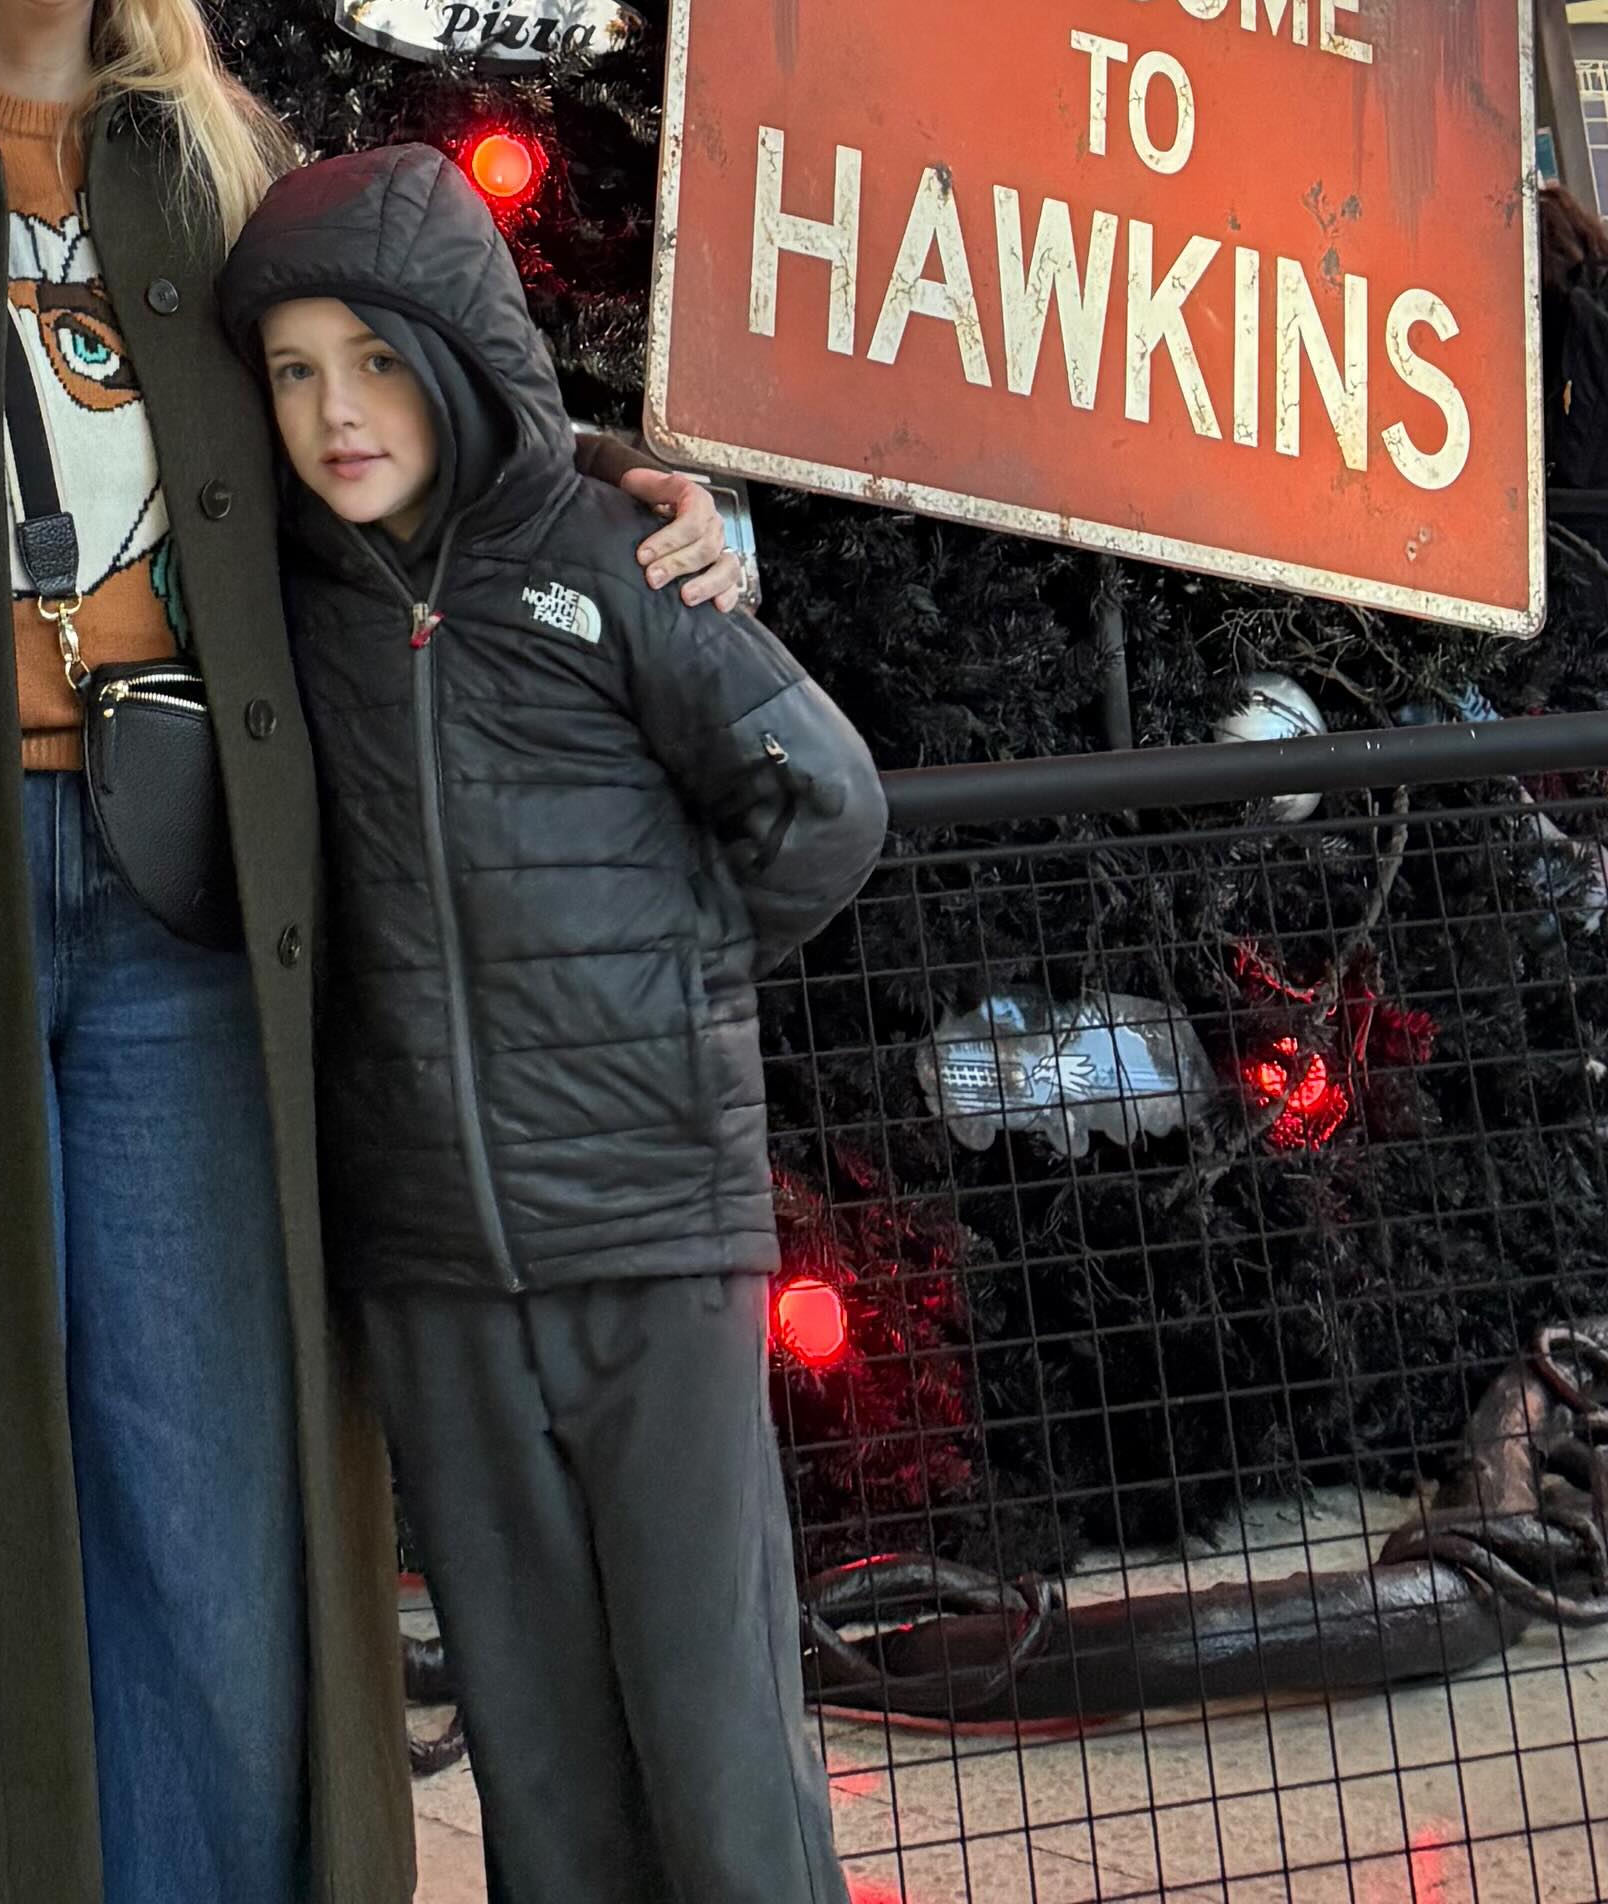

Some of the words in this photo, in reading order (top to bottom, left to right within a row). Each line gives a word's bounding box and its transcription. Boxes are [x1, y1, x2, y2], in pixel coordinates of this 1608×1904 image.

[432, 1, 597, 53] Pizza
[1069, 28, 1196, 177] TO
[748, 124, 1473, 492] HAWKINS
[521, 586, 577, 619] NORTH
[550, 582, 580, 604] THE
[533, 606, 573, 632] FACE
